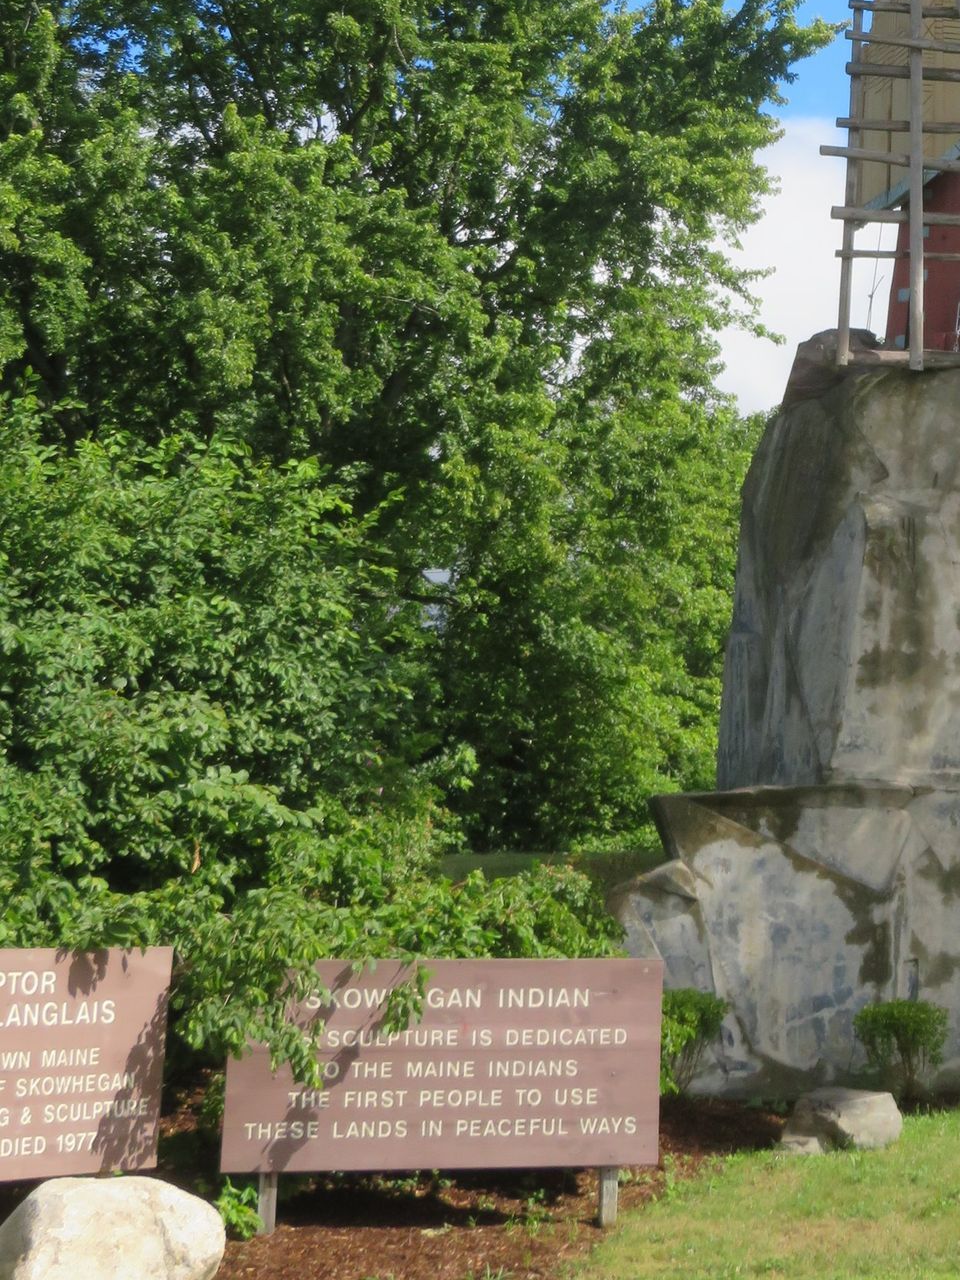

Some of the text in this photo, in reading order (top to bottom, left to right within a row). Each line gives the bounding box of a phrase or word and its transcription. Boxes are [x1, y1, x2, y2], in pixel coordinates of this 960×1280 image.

[306, 988, 590, 1008] SKOWGAN INDIAN
[0, 1000, 115, 1028] ANGLAIS
[327, 1030, 458, 1048] SCULPTURE
[472, 1029, 492, 1046] IS
[506, 1028, 627, 1046] DEDICATED
[41, 1048, 100, 1067] MAINE
[351, 1061, 392, 1078] THE
[407, 1060, 475, 1078] MAINE
[488, 1059, 578, 1077] INDIANS
[16, 1072, 136, 1097] SKOWHEGAN
[288, 1088, 598, 1108] THE FIRST PEOPLE TO USE
[20, 1106, 32, 1125] &
[44, 1096, 151, 1124] SCULPTURE
[244, 1116, 637, 1140] THESE LANDS IN PEACEFUL WAYS
[0, 1131, 97, 1157] DIED 1977
